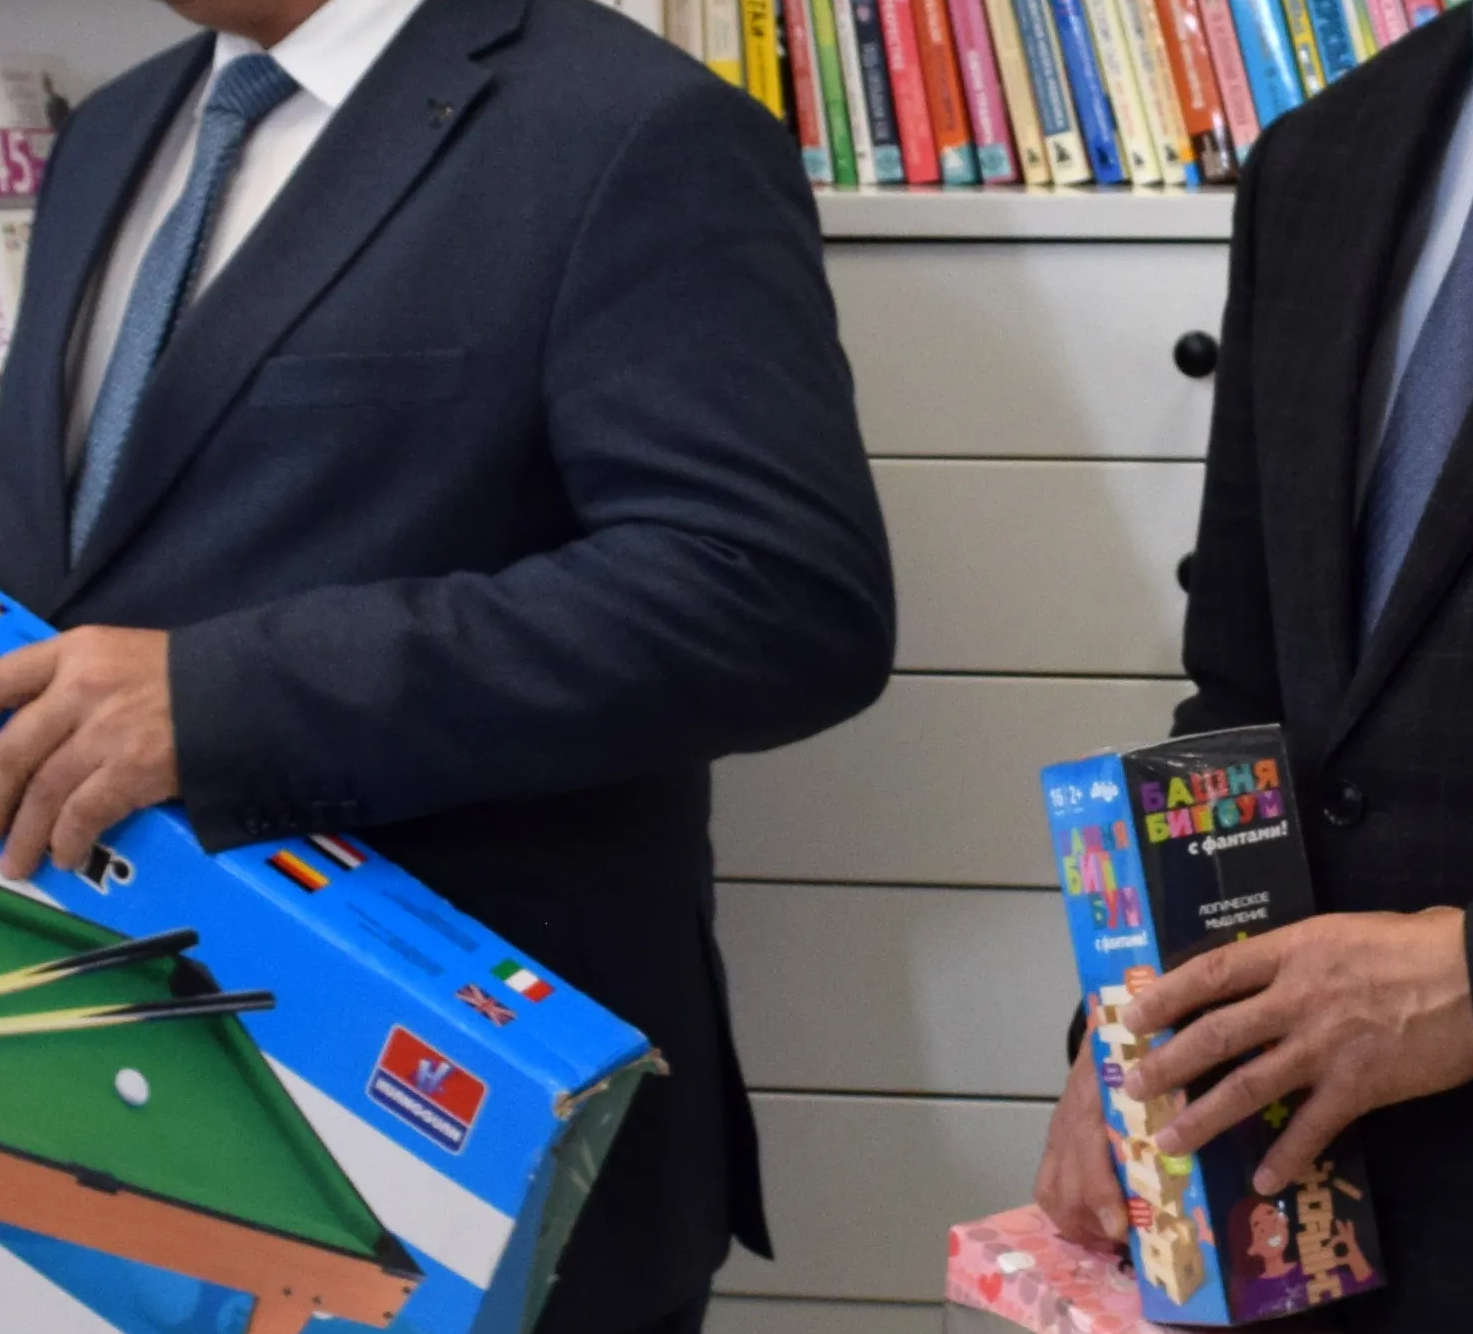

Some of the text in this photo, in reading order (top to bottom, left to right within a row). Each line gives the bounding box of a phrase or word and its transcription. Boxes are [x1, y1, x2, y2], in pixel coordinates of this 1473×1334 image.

[1139, 759, 1281, 812] БАШНЯ
[1201, 821, 1289, 855] фантами!
[1198, 891, 1271, 917] ЛОГИЧЕСКОЕ
[1204, 907, 1269, 931] МЫШЛЕНИЕ
